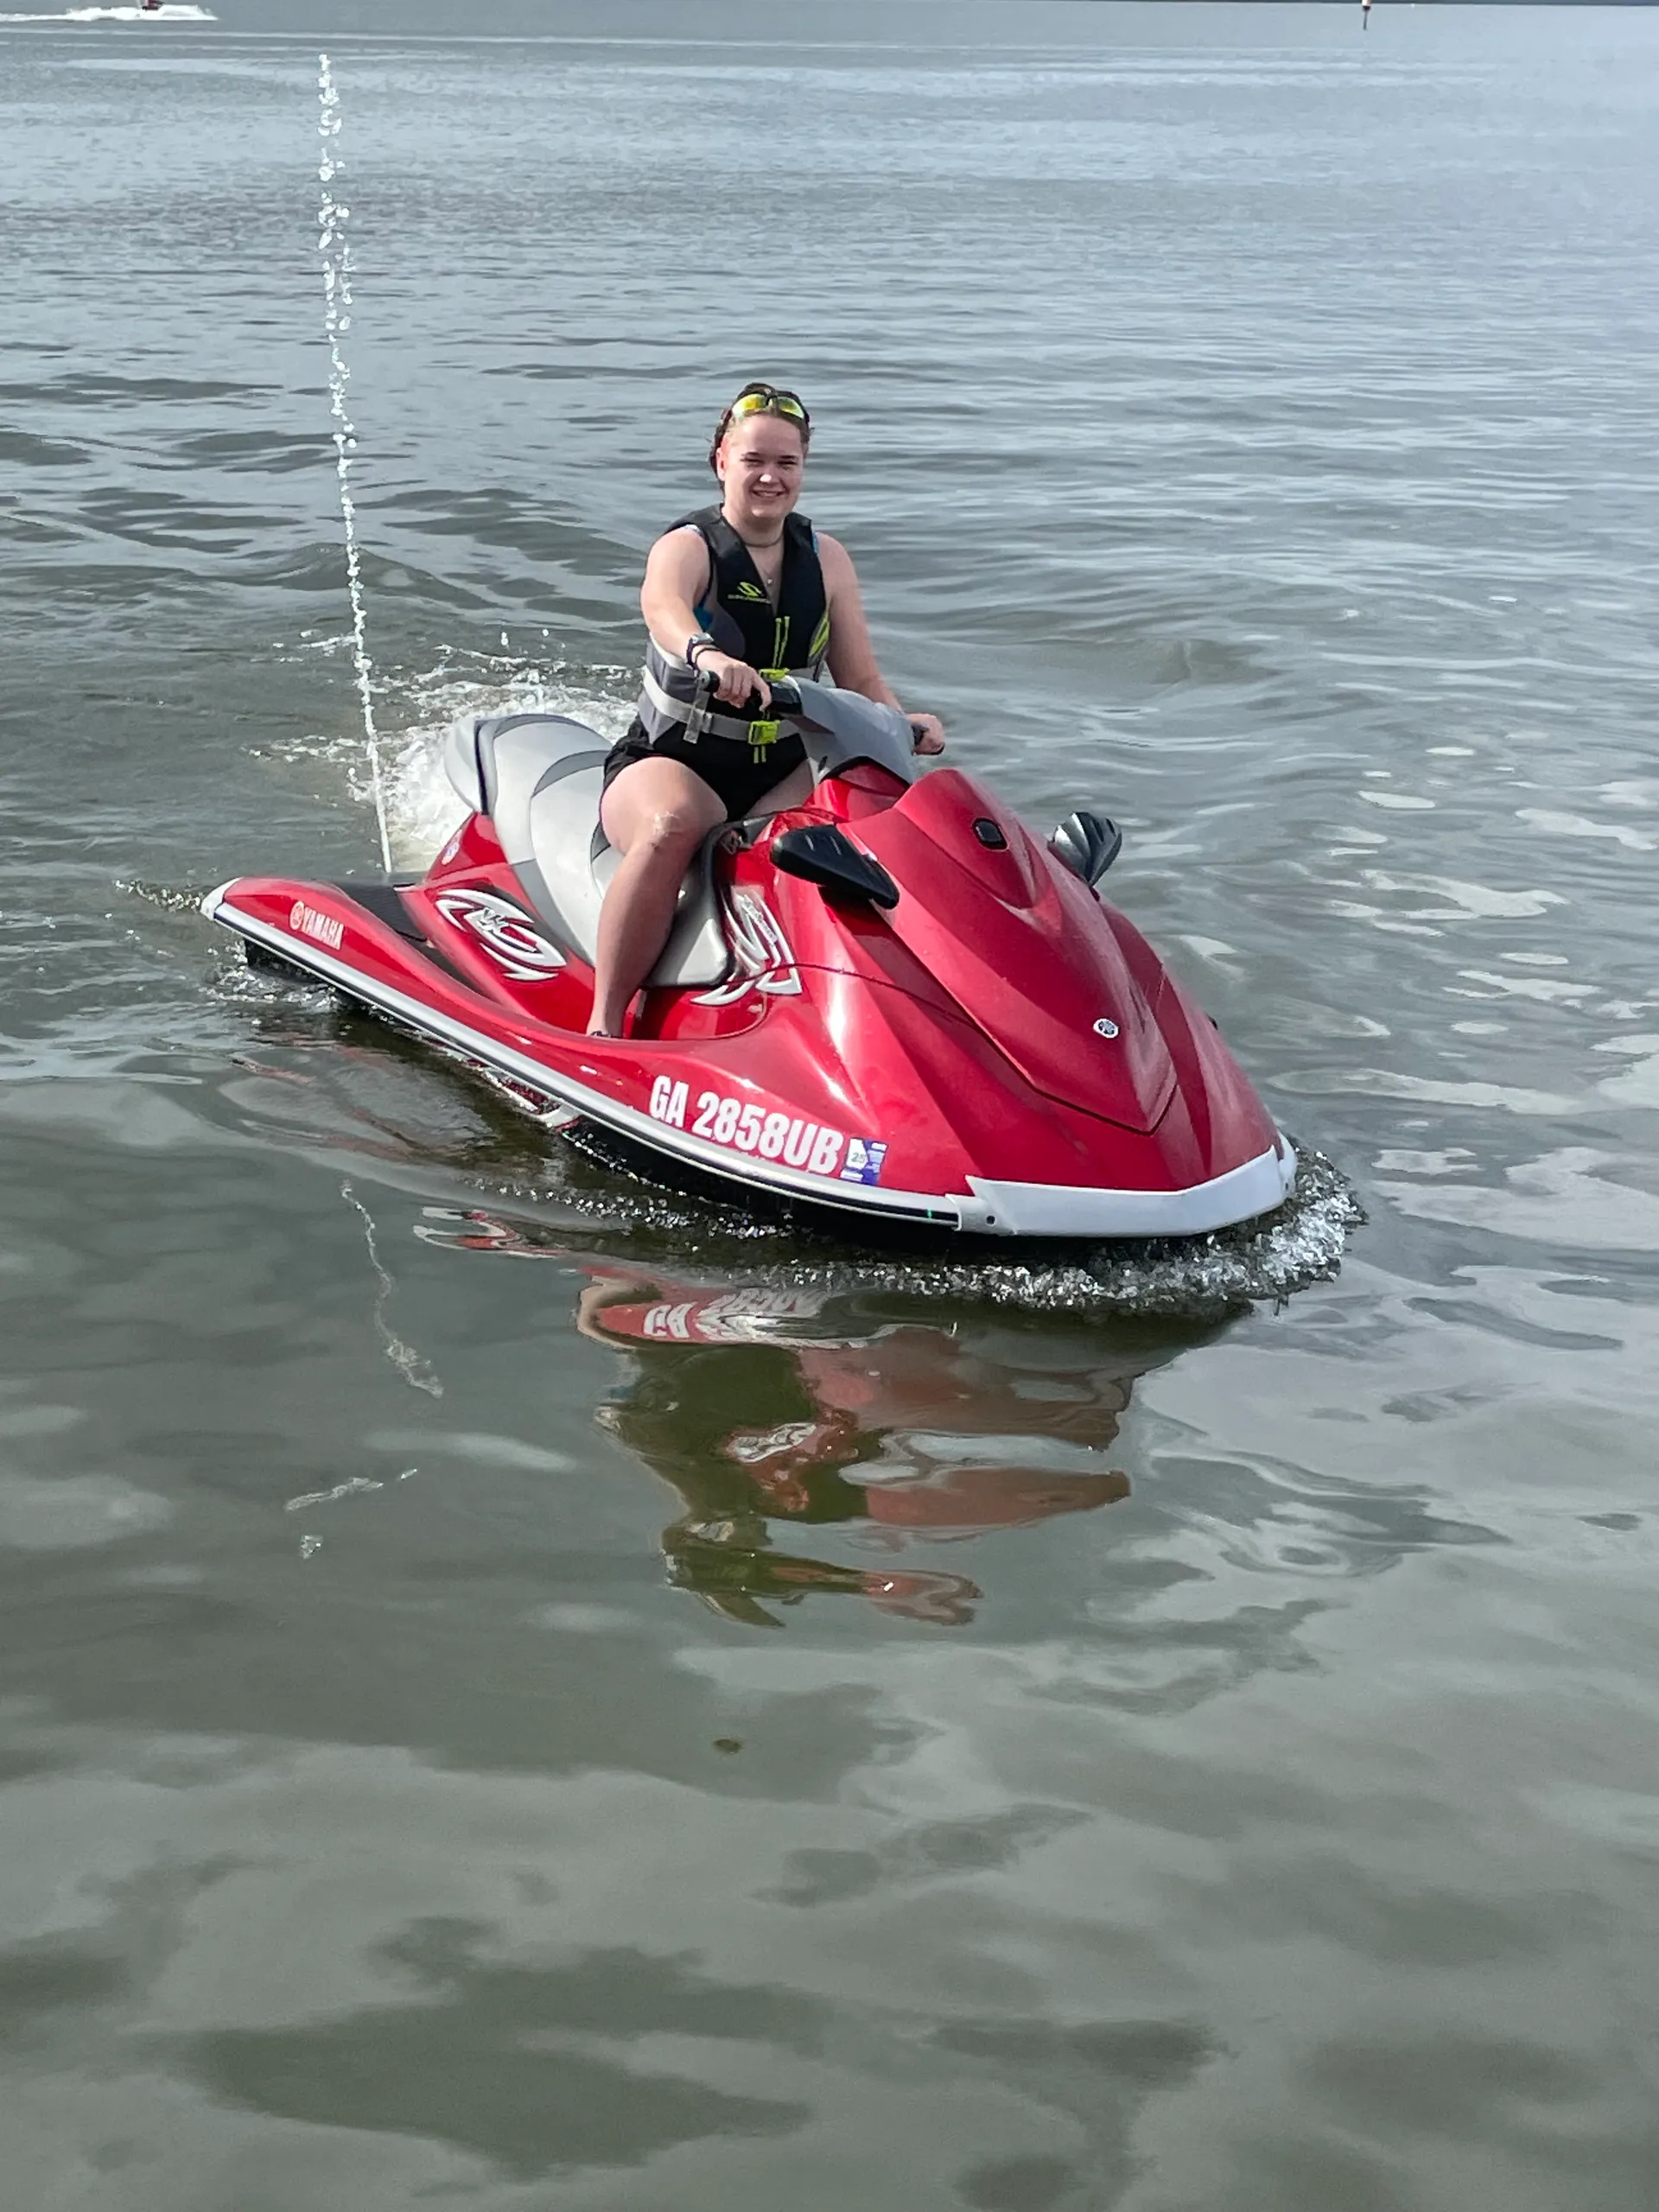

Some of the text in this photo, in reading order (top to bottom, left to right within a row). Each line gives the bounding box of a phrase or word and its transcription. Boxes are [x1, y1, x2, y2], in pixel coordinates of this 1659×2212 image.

[301, 906, 344, 950] YAMAHA
[650, 1076, 843, 1174] GA 2858UB
